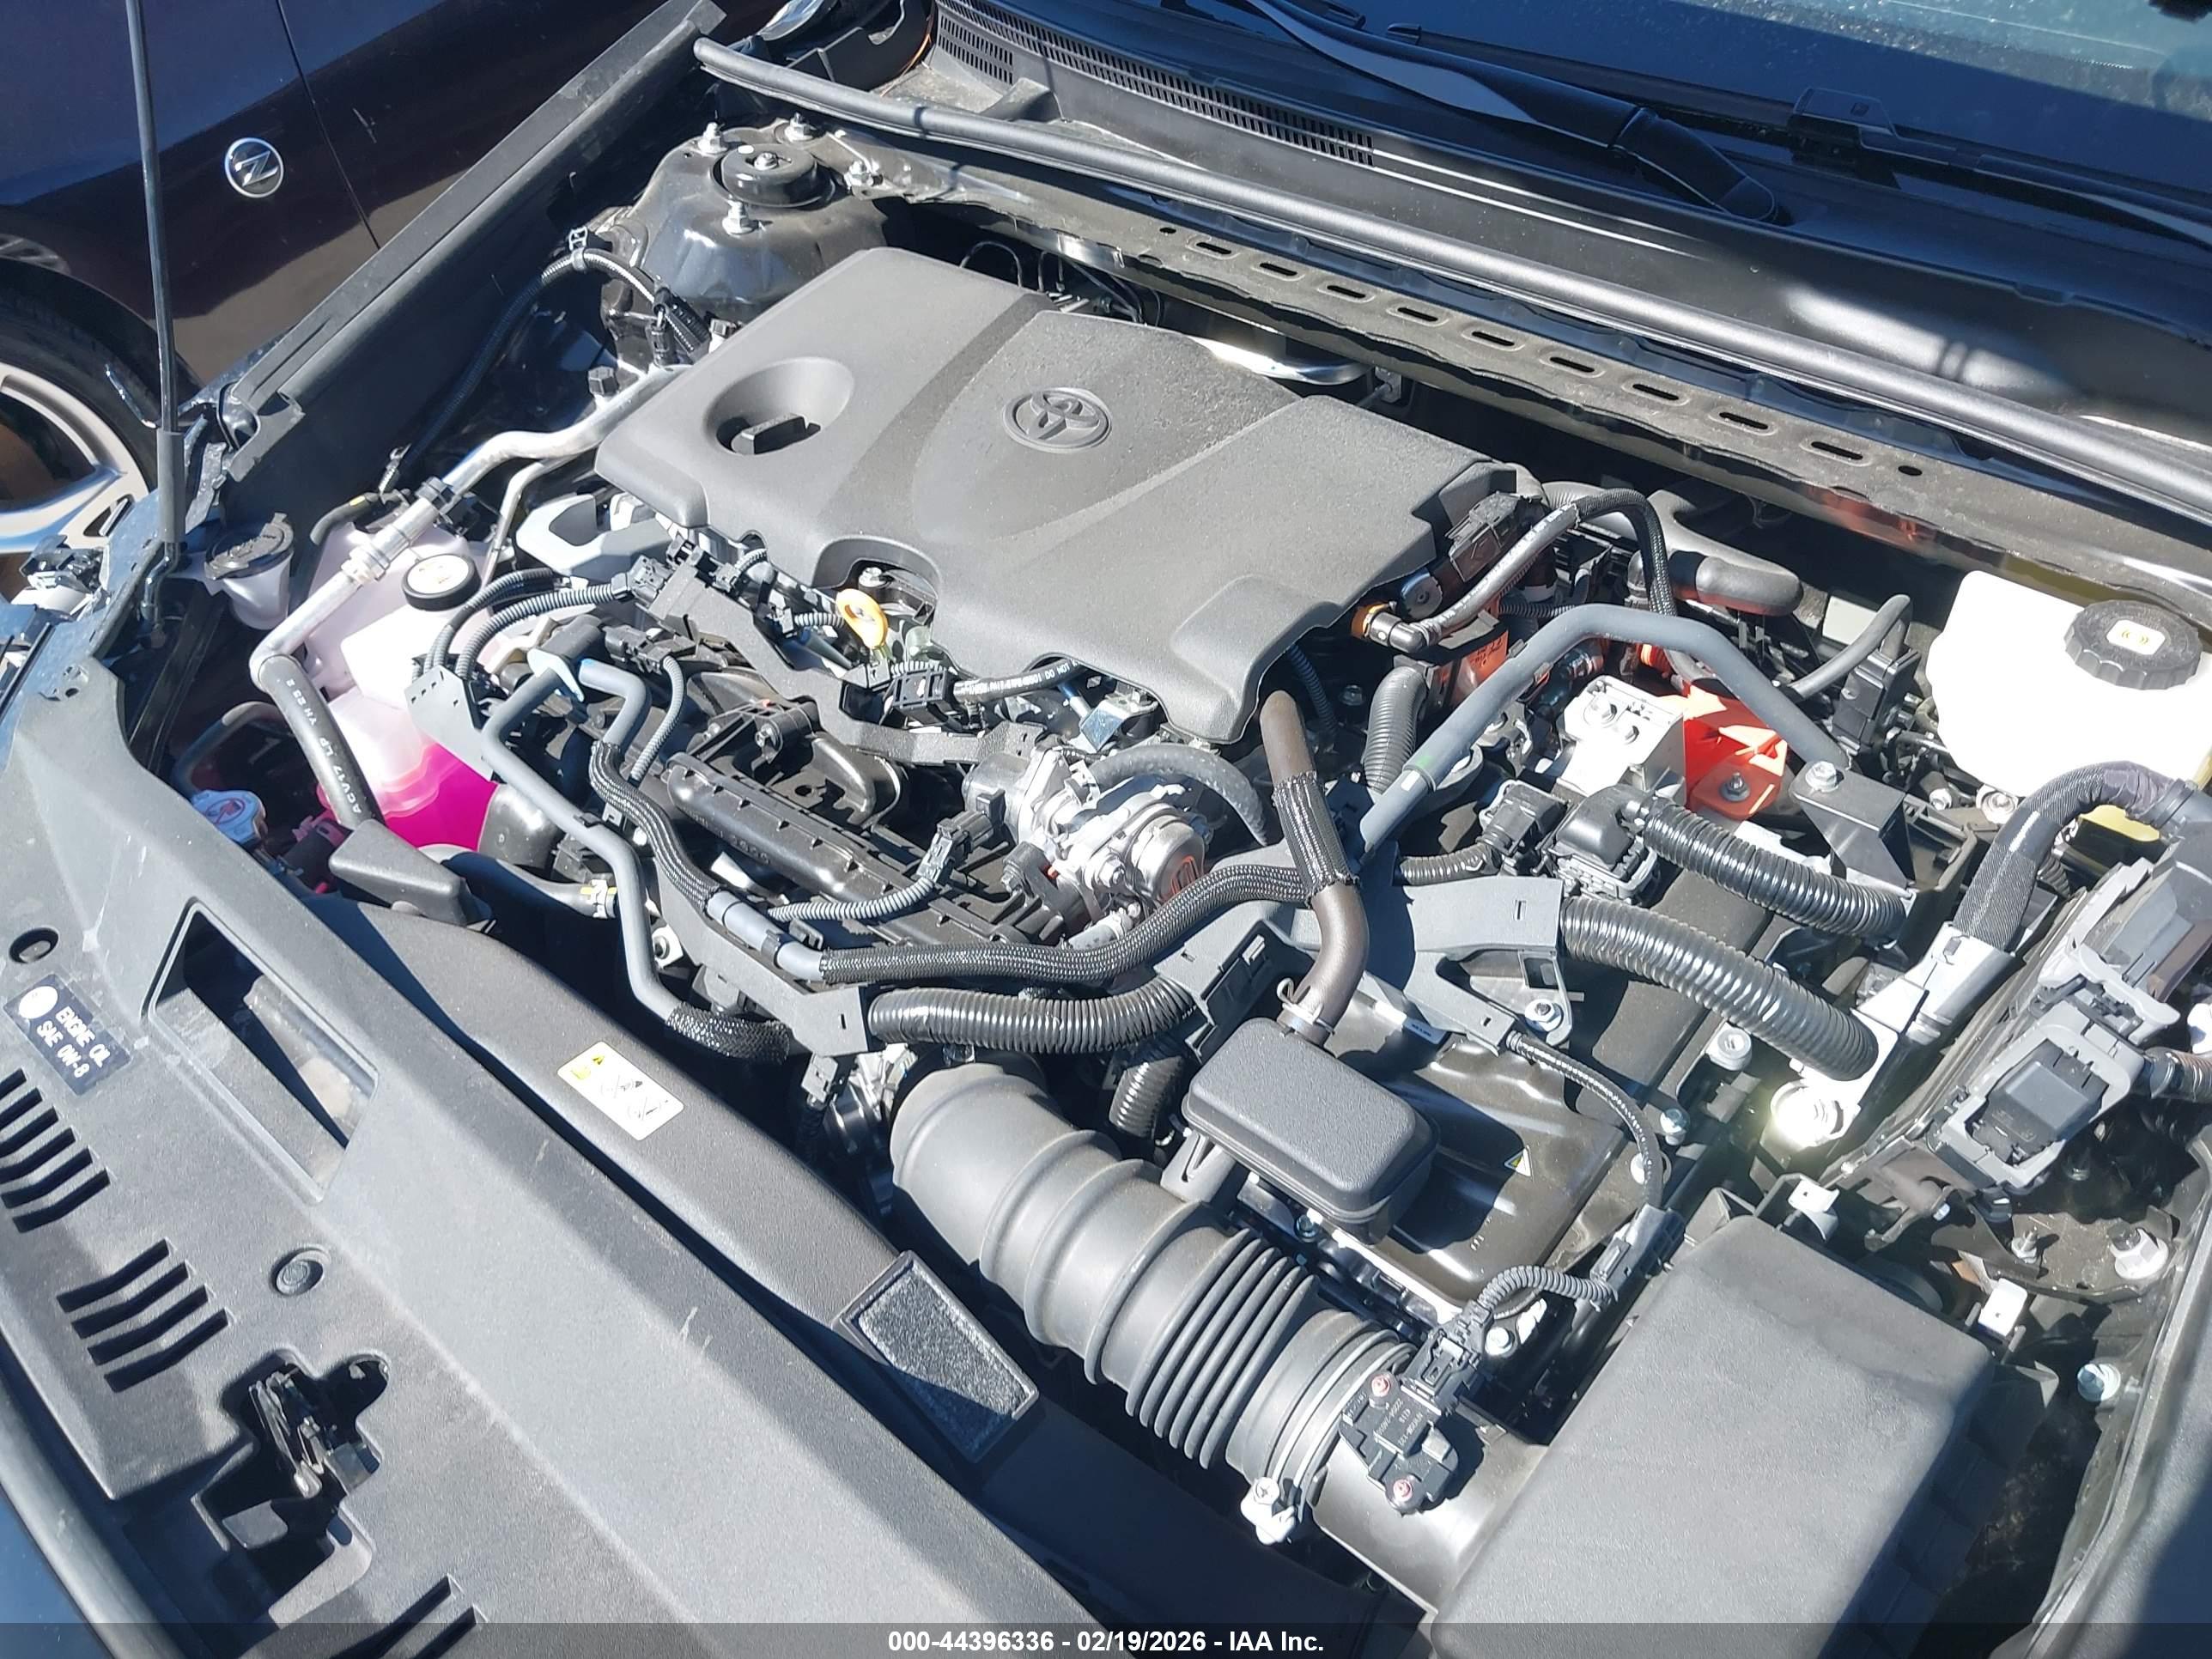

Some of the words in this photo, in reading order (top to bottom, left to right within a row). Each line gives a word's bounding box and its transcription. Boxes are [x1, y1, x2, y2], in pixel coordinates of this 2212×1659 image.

[319, 737, 334, 757] LP
[37, 1020, 64, 1048] SAE
[55, 1006, 95, 1048] ENGINE
[89, 1043, 111, 1068] OIL
